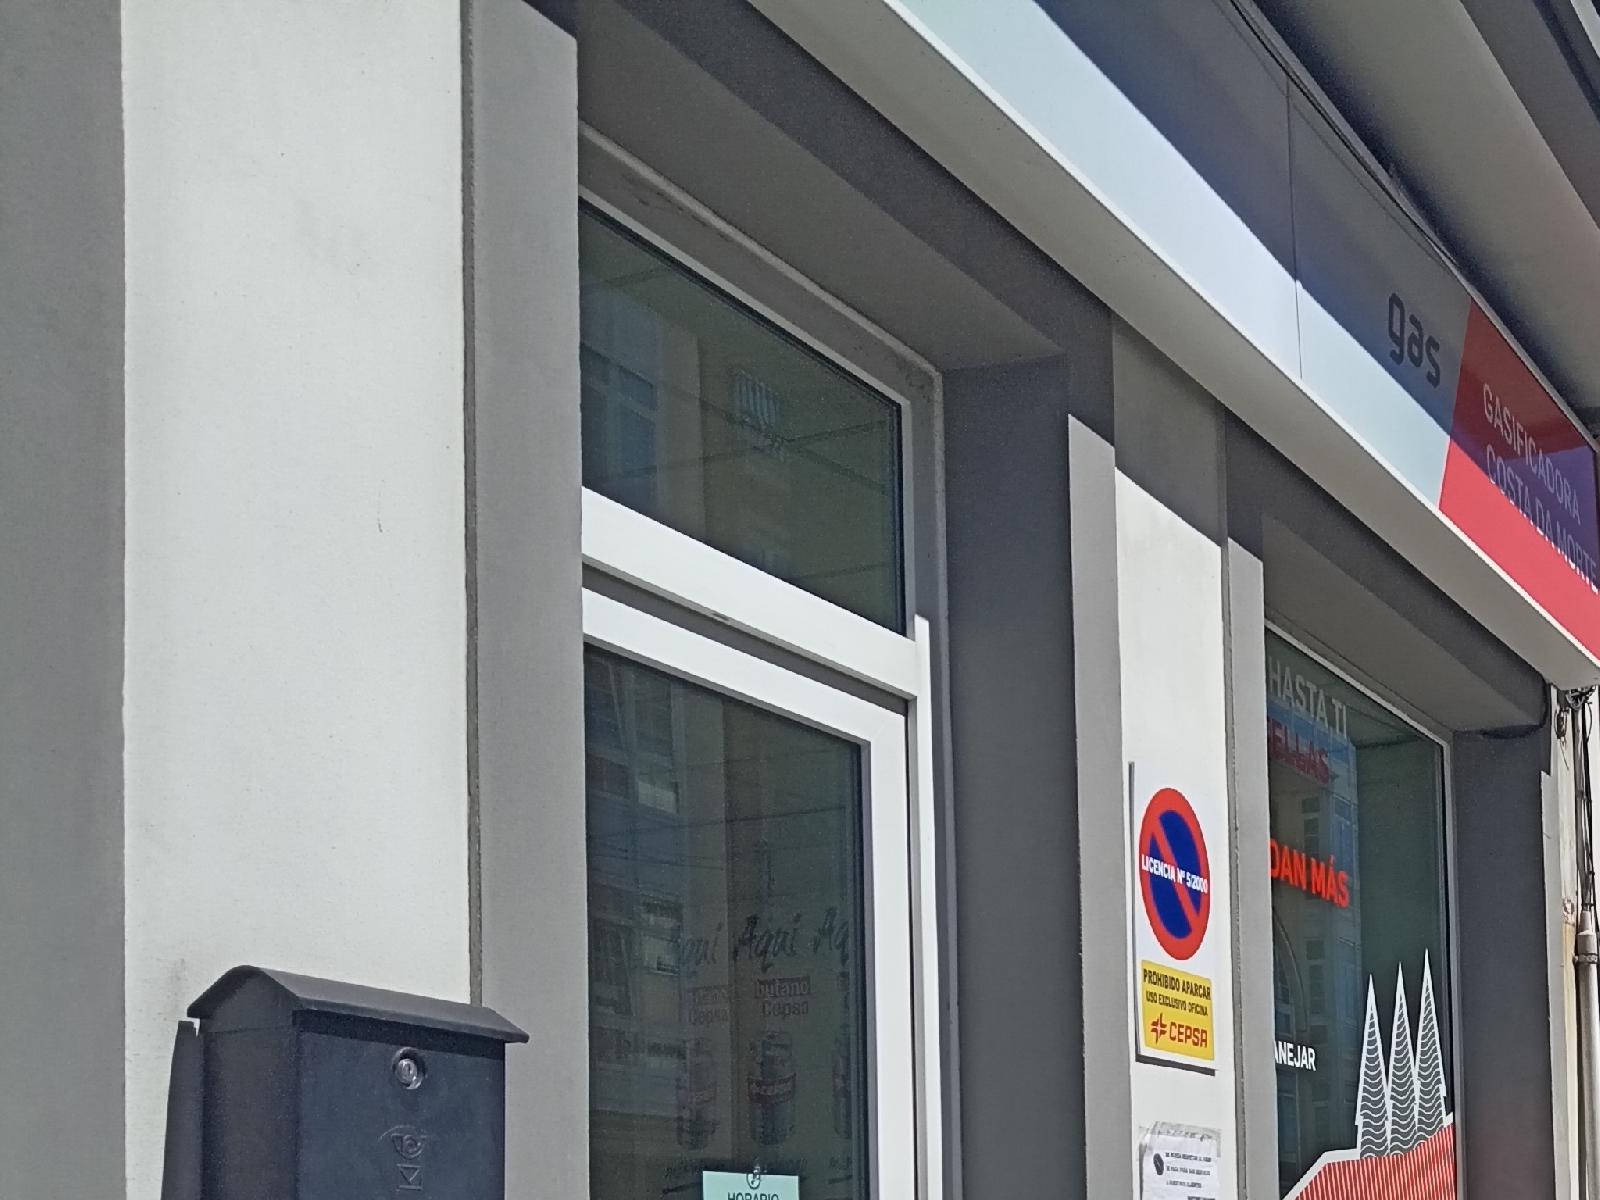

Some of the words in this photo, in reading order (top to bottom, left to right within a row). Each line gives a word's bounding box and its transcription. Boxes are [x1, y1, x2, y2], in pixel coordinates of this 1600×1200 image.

[1387, 292, 1441, 389] gas
[1482, 383, 1582, 525] GASIFICADORA
[1486, 444, 1533, 525] COSTA
[1535, 500, 1555, 545] DA
[1556, 526, 1600, 594] MORTE
[1269, 655, 1329, 729] HASTA
[1332, 695, 1347, 739] TI
[1267, 717, 1330, 785] ELLAS
[1141, 853, 1176, 883] LICENCIA
[1269, 838, 1307, 891] DAN
[1310, 854, 1350, 909] MÁS
[1143, 968, 1181, 993] PROHIBIDO
[1181, 979, 1212, 1001] APARCAR
[1145, 989, 1158, 1004] USO
[1158, 993, 1187, 1012] EXCLUSIVO
[1188, 1001, 1209, 1017] OFICINA
[1168, 1020, 1208, 1049] CEPSA
